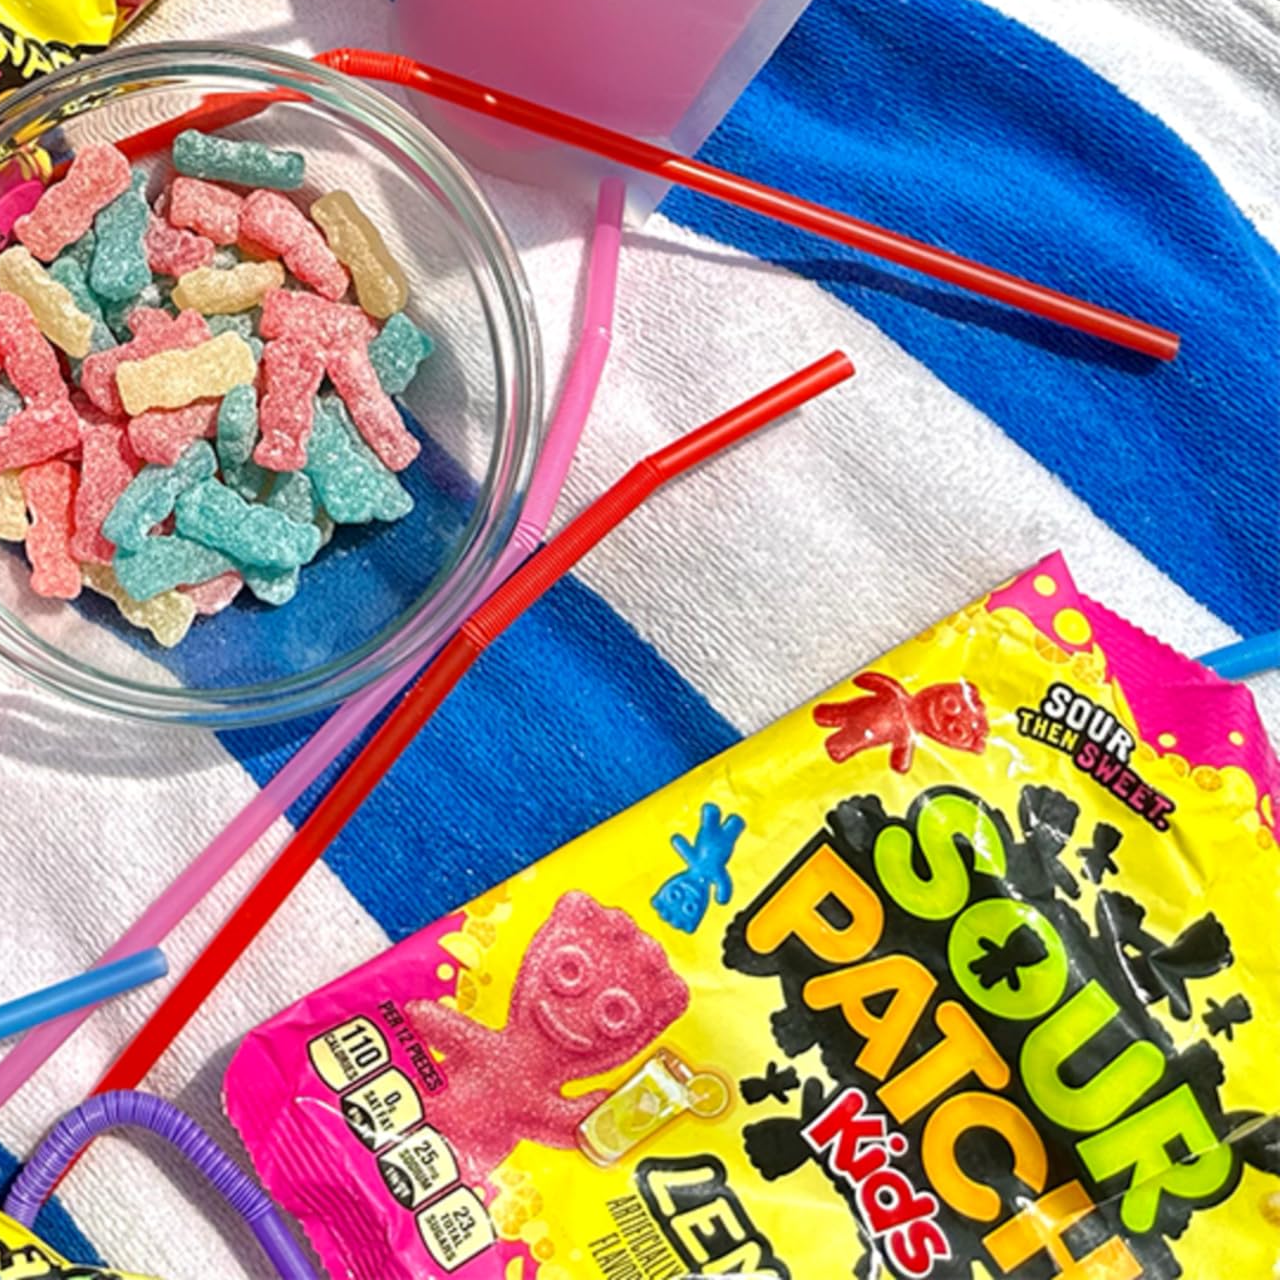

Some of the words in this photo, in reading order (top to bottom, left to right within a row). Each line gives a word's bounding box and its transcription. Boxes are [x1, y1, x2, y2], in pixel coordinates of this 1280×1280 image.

[1042, 684, 1135, 763] SOUR
[1019, 711, 1079, 752] THEN
[1075, 741, 1173, 829] SWEET.
[340, 1023, 382, 1068] 110
[378, 1000, 404, 1030] PER
[395, 1026, 415, 1047] 12
[407, 1041, 445, 1093] PIECES
[873, 793, 1233, 1233] SOUR
[323, 1032, 359, 1081] CALORIES
[745, 843, 1144, 1280] PATCH
[803, 1087, 951, 1278] Kids
[424, 1213, 457, 1263] SUGARS
[439, 1211, 465, 1249] TOTAL
